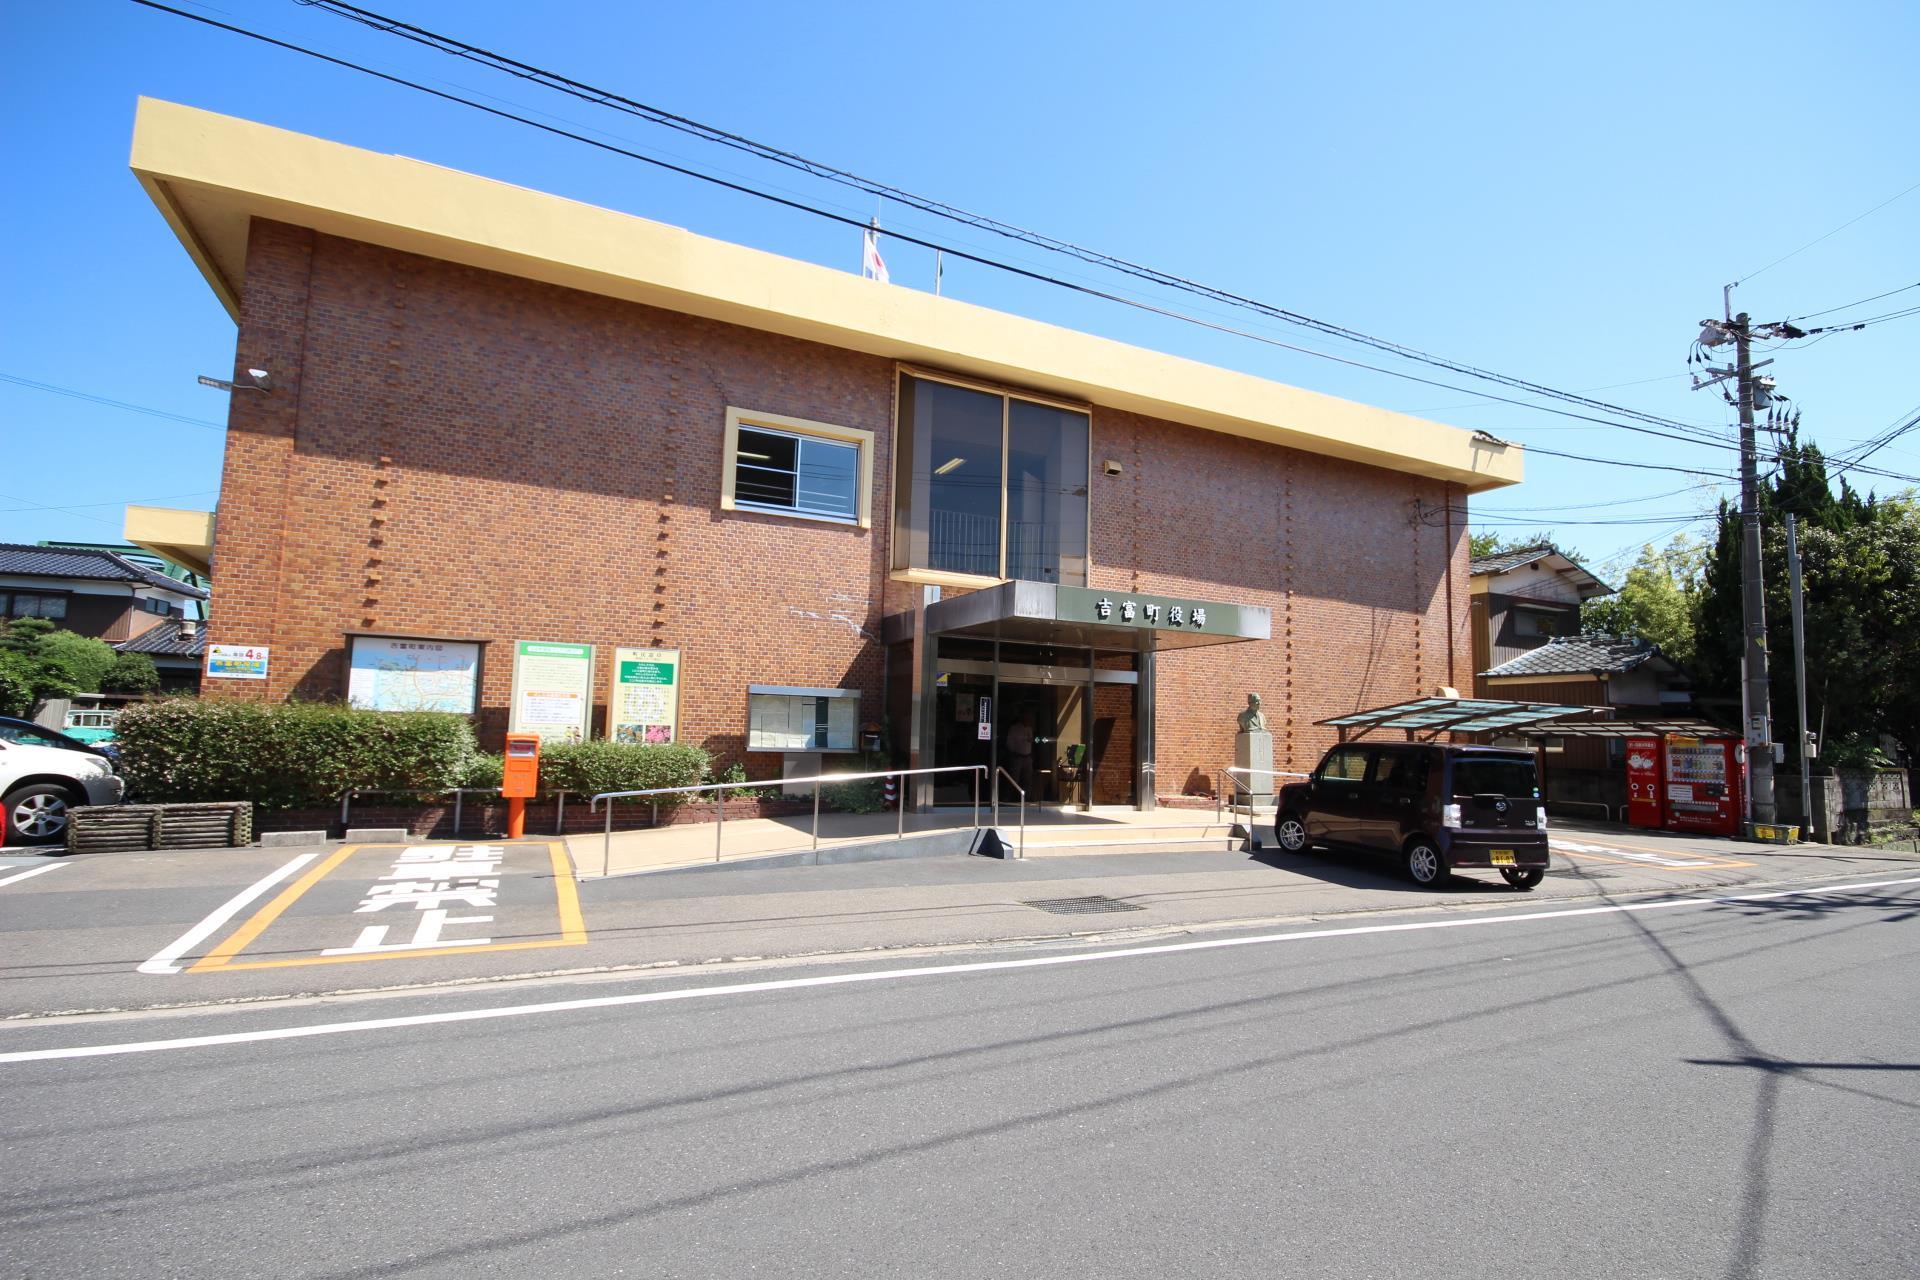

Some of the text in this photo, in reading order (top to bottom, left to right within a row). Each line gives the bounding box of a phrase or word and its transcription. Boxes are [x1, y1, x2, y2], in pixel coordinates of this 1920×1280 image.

[1098, 598, 1206, 625] 吉富町役場
[320, 845, 504, 956] 駐車禁止
